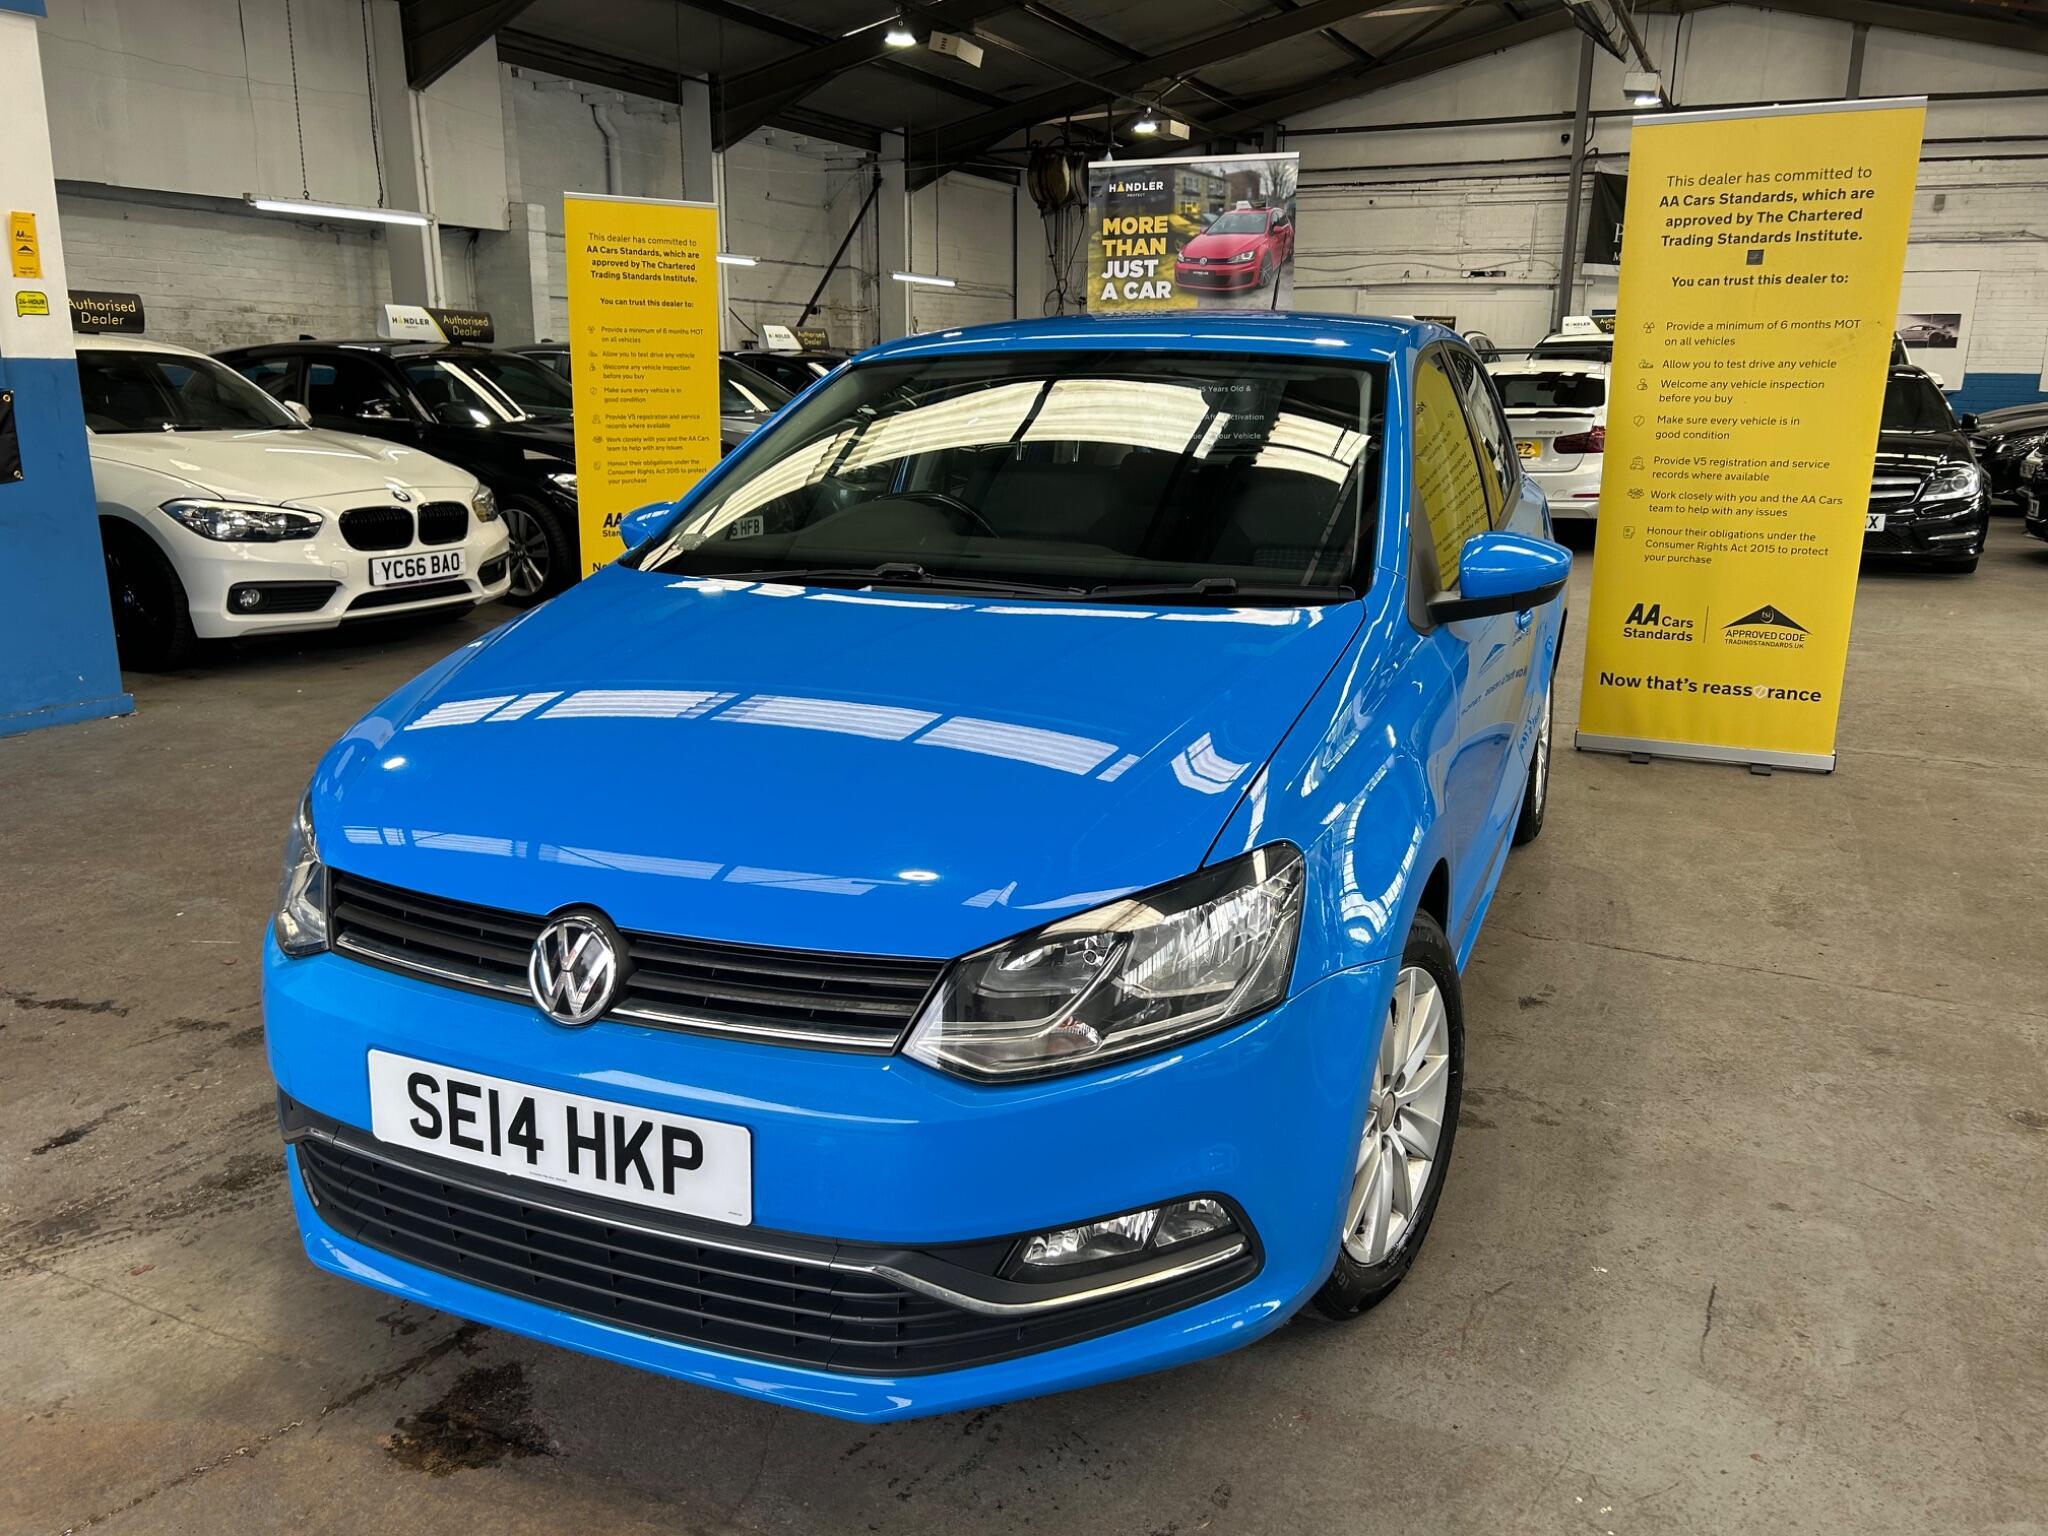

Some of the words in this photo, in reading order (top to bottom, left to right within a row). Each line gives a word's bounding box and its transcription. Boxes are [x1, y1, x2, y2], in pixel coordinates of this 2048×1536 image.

[1666, 175, 1694, 187] This
[1698, 172, 1742, 186] dealer
[1745, 171, 1770, 183] has
[1774, 166, 1853, 182] committed
[1857, 166, 1872, 179] to
[1659, 195, 1679, 208] AA
[1683, 194, 1715, 206] Cars
[1719, 190, 1797, 205] Standards,
[1802, 187, 1846, 201] which
[1850, 189, 1875, 199] are
[1665, 212, 1732, 229] approved
[1736, 212, 1753, 226] by
[1756, 211, 1783, 223] The
[1787, 207, 1863, 222] Chartered
[1102, 215, 1169, 236] MORE
[590, 232, 605, 241] This
[607, 234, 631, 243] dealer
[633, 235, 646, 244] has
[648, 237, 688, 246] committed
[689, 239, 697, 247] to
[1661, 234, 1713, 247] Trading
[1717, 230, 1791, 245] Standards
[1795, 228, 1862, 242] Institute.
[587, 245, 598, 253] AA
[600, 246, 618, 255] Cars
[620, 247, 662, 258] Standards,
[664, 250, 686, 258] which
[1102, 237, 1167, 257] THAN
[592, 259, 629, 267] approved
[631, 259, 640, 269] by
[642, 260, 656, 269] The
[658, 261, 695, 271] Chartered
[1101, 259, 1159, 279] JUST
[591, 270, 620, 280] Trading
[623, 271, 662, 281] Standards
[663, 273, 697, 283] Institute.
[1672, 276, 1694, 287] You
[1697, 277, 1720, 286] can
[1723, 275, 1754, 286] trust
[1758, 273, 1781, 285] this
[1785, 273, 1827, 284] dealer
[1831, 273, 1848, 283] to:
[1100, 282, 1119, 300] A
[1123, 281, 1172, 300] CAR
[68, 297, 136, 312] Authorised
[600, 297, 613, 305] You
[629, 298, 646, 306] trust
[648, 299, 660, 307] this
[81, 311, 124, 325] Dealer
[443, 315, 489, 327] Authorised
[1666, 321, 1704, 331] Provide
[1716, 320, 1764, 330] minimum
[1767, 320, 1778, 330] of
[1780, 319, 1788, 330] 6
[1790, 319, 1831, 329] months
[1834, 319, 1861, 329] MOT
[452, 325, 482, 336] Dealer
[1664, 338, 1677, 346] on
[1679, 336, 1691, 346] all
[1694, 336, 1735, 346] vehicles
[1662, 359, 1690, 368] Allow
[1692, 361, 1711, 370] you
[1713, 359, 1724, 369] to
[1726, 359, 1746, 368] test
[1748, 359, 1775, 368] drive
[1777, 360, 1796, 370] any
[1798, 359, 1837, 368] vehicle
[1230, 384, 1245, 392] Old
[1660, 379, 1708, 388] Welcome
[1709, 381, 1728, 390] any
[1730, 379, 1767, 389] vehicle
[1769, 379, 1825, 390] inspection
[1658, 393, 1691, 402] before
[1693, 395, 1712, 404] you
[1714, 393, 1733, 405] buy
[1656, 415, 1684, 424] Make
[1686, 417, 1708, 425] sure
[1710, 417, 1738, 427] every
[1739, 416, 1777, 425] vehicle
[1790, 416, 1800, 425] in
[1233, 432, 1262, 440] Vehicle
[1655, 430, 1681, 440] good
[1682, 430, 1730, 440] condition
[1653, 455, 1691, 465] Provide
[1693, 456, 1707, 466] V5
[1709, 457, 1767, 468] registration
[1769, 459, 1790, 468] and
[1792, 460, 1830, 469] service
[1652, 470, 1689, 479] records
[1691, 471, 1722, 480] where
[1724, 472, 1770, 481] available
[1650, 490, 1676, 499] Work
[1678, 491, 1713, 502] closely
[1715, 492, 1736, 502] with
[1738, 495, 1757, 503] you
[1759, 494, 1779, 503] and
[1782, 494, 1799, 503] the
[1800, 495, 1816, 504] AA
[1818, 495, 1843, 505] Cars
[1648, 504, 1673, 513] team
[1675, 504, 1686, 513] to
[1687, 505, 1709, 516] help
[1711, 506, 1733, 515] with
[1735, 508, 1754, 517] any
[1755, 507, 1788, 517] issues
[1646, 527, 1683, 536] Honour
[1685, 527, 1707, 537] their
[1709, 529, 1764, 540] obligations
[1767, 531, 1797, 541] under
[1799, 532, 1816, 541] the
[1645, 540, 1695, 549] Consumer
[1696, 541, 1728, 553] Rights
[1730, 543, 1747, 552] Act
[1750, 543, 1775, 553] 2015
[1777, 545, 1788, 554] to
[1790, 547, 1828, 556] protect
[1643, 554, 1666, 562] your
[1667, 554, 1712, 564] purchase
[381, 558, 427, 581] YC66
[430, 552, 461, 575] BAO
[1625, 603, 1660, 626] AA
[1661, 615, 1694, 628] Cars
[1623, 627, 1693, 641] Standards
[1725, 629, 1777, 640] APPROVED
[1778, 632, 1806, 642] CODE
[1600, 671, 1642, 688] Now
[1646, 675, 1698, 692] that's
[407, 1072, 545, 1165] SE14
[565, 1105, 704, 1196] HKP
